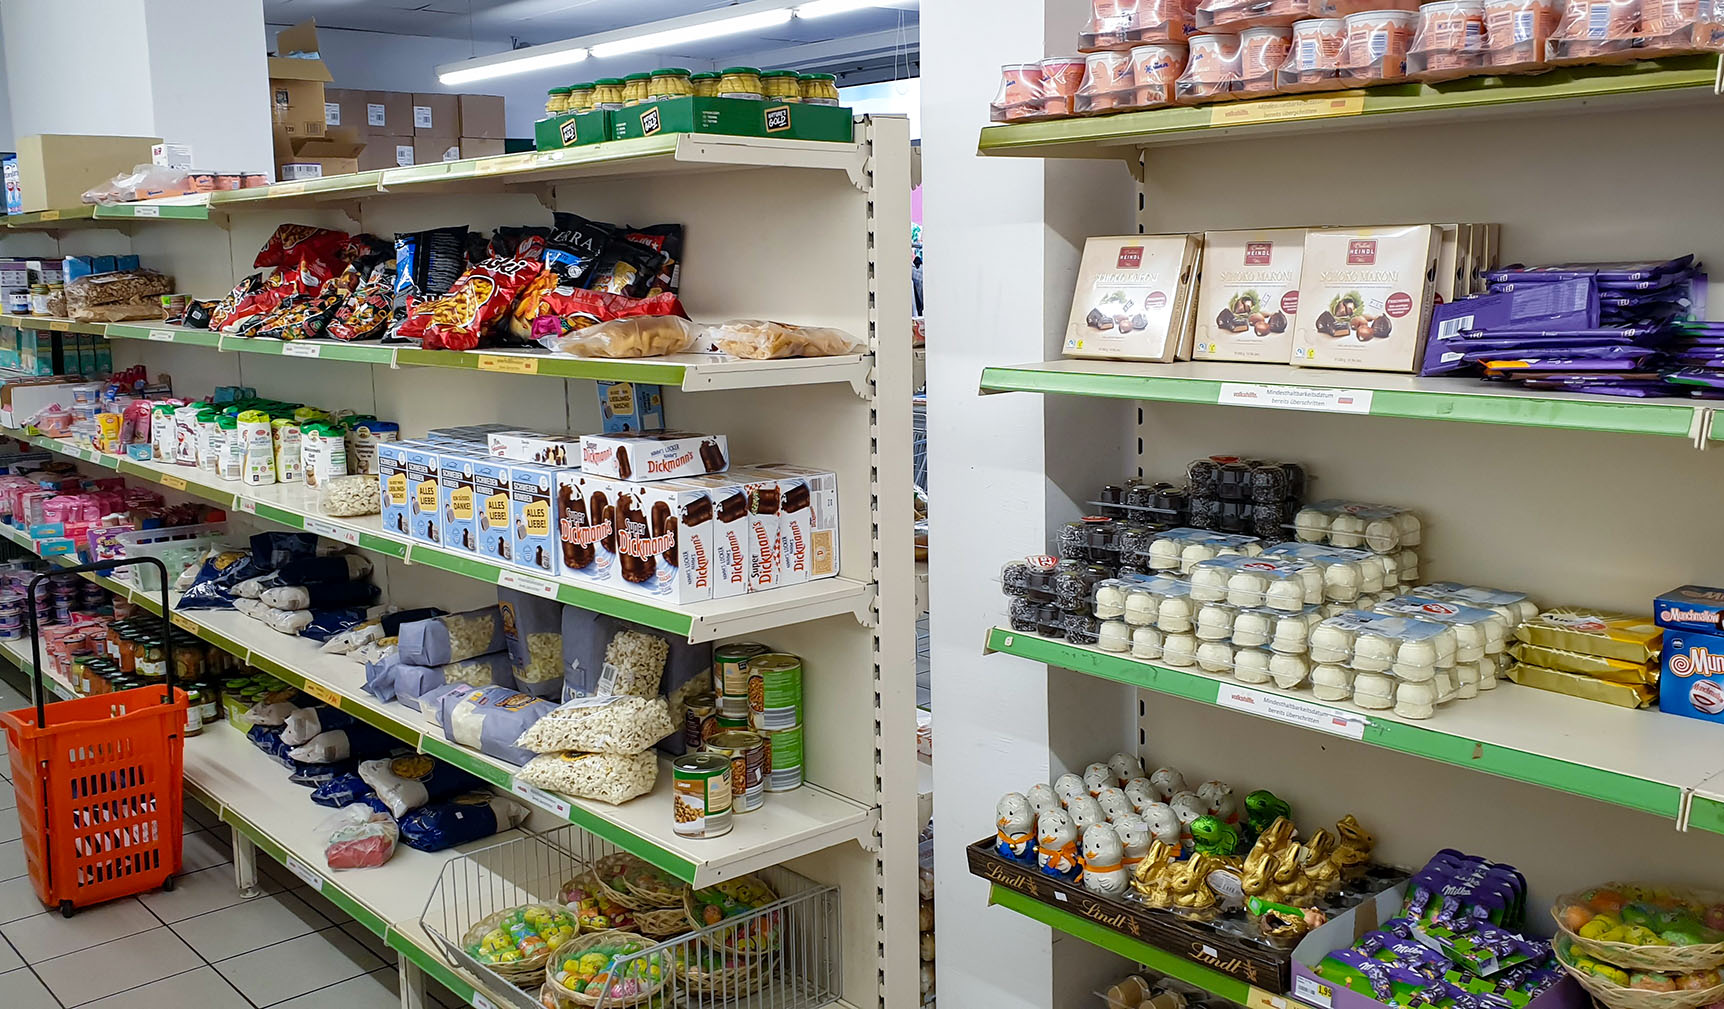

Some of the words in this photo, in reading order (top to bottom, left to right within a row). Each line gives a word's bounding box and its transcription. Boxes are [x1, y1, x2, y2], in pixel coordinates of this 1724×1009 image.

[769, 115, 786, 128] GOLD
[583, 446, 612, 465] Dickmann's
[647, 451, 694, 474] Dickmann's
[420, 486, 434, 495] ALLES
[488, 501, 505, 510] ALLES
[490, 511, 506, 520] LIEBE!
[526, 508, 544, 518] ALLES
[528, 520, 546, 528] LIEBE!
[566, 508, 585, 524] Super
[561, 520, 612, 548] Dickmann's
[625, 518, 646, 535] Super
[619, 530, 675, 561] Dickmann's
[752, 521, 774, 585] Dickmann's
[788, 520, 806, 572] Dickmann's
[690, 534, 709, 589] Dickmann's
[726, 530, 744, 584] Dickmann's
[750, 554, 760, 578] Super
[1264, 697, 1329, 718] Mindesthaltbarkeitsdatum
[1268, 708, 1285, 716] bereits
[1286, 710, 1320, 724] überschritten
[985, 862, 1027, 890] Lindt
[1442, 884, 1472, 896] Milka
[1080, 900, 1126, 930] Lindt
[1188, 942, 1244, 974] Lindt
[1392, 944, 1423, 955] Milka
